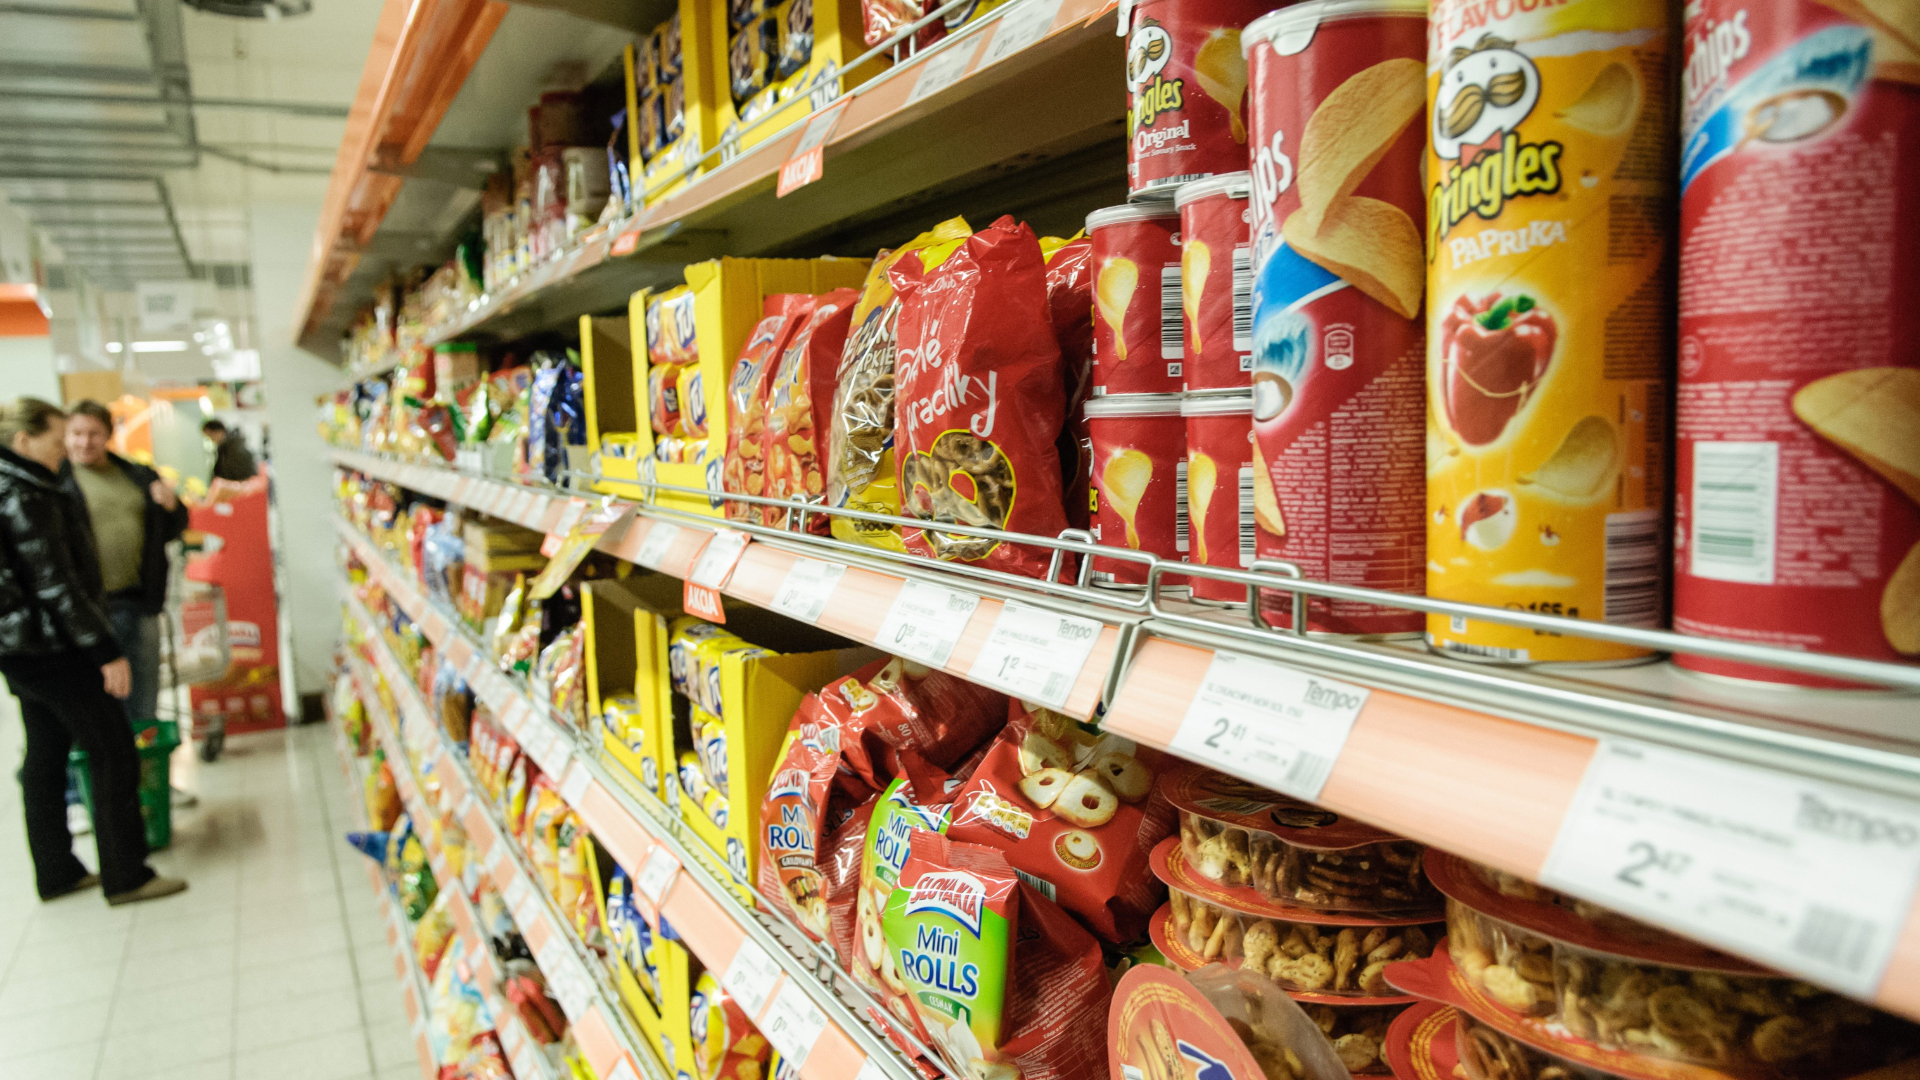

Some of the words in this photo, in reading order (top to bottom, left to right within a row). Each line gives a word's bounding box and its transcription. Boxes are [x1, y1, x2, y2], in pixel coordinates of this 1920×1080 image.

[1437, 0, 1568, 49] FLAVOU
[1137, 119, 1190, 152] Original
[1430, 130, 1563, 266] Pringles
[1449, 219, 1568, 270] PAPRIKA
[687, 585, 719, 617] AKCIA
[949, 593, 975, 612] Tempo
[1058, 618, 1092, 641] Tempo
[1306, 679, 1360, 712] Tempo
[770, 825, 815, 851] ROLL
[910, 876, 977, 923] SLOVAKIA
[916, 924, 960, 956] Mini
[901, 949, 979, 998] ROLLS
